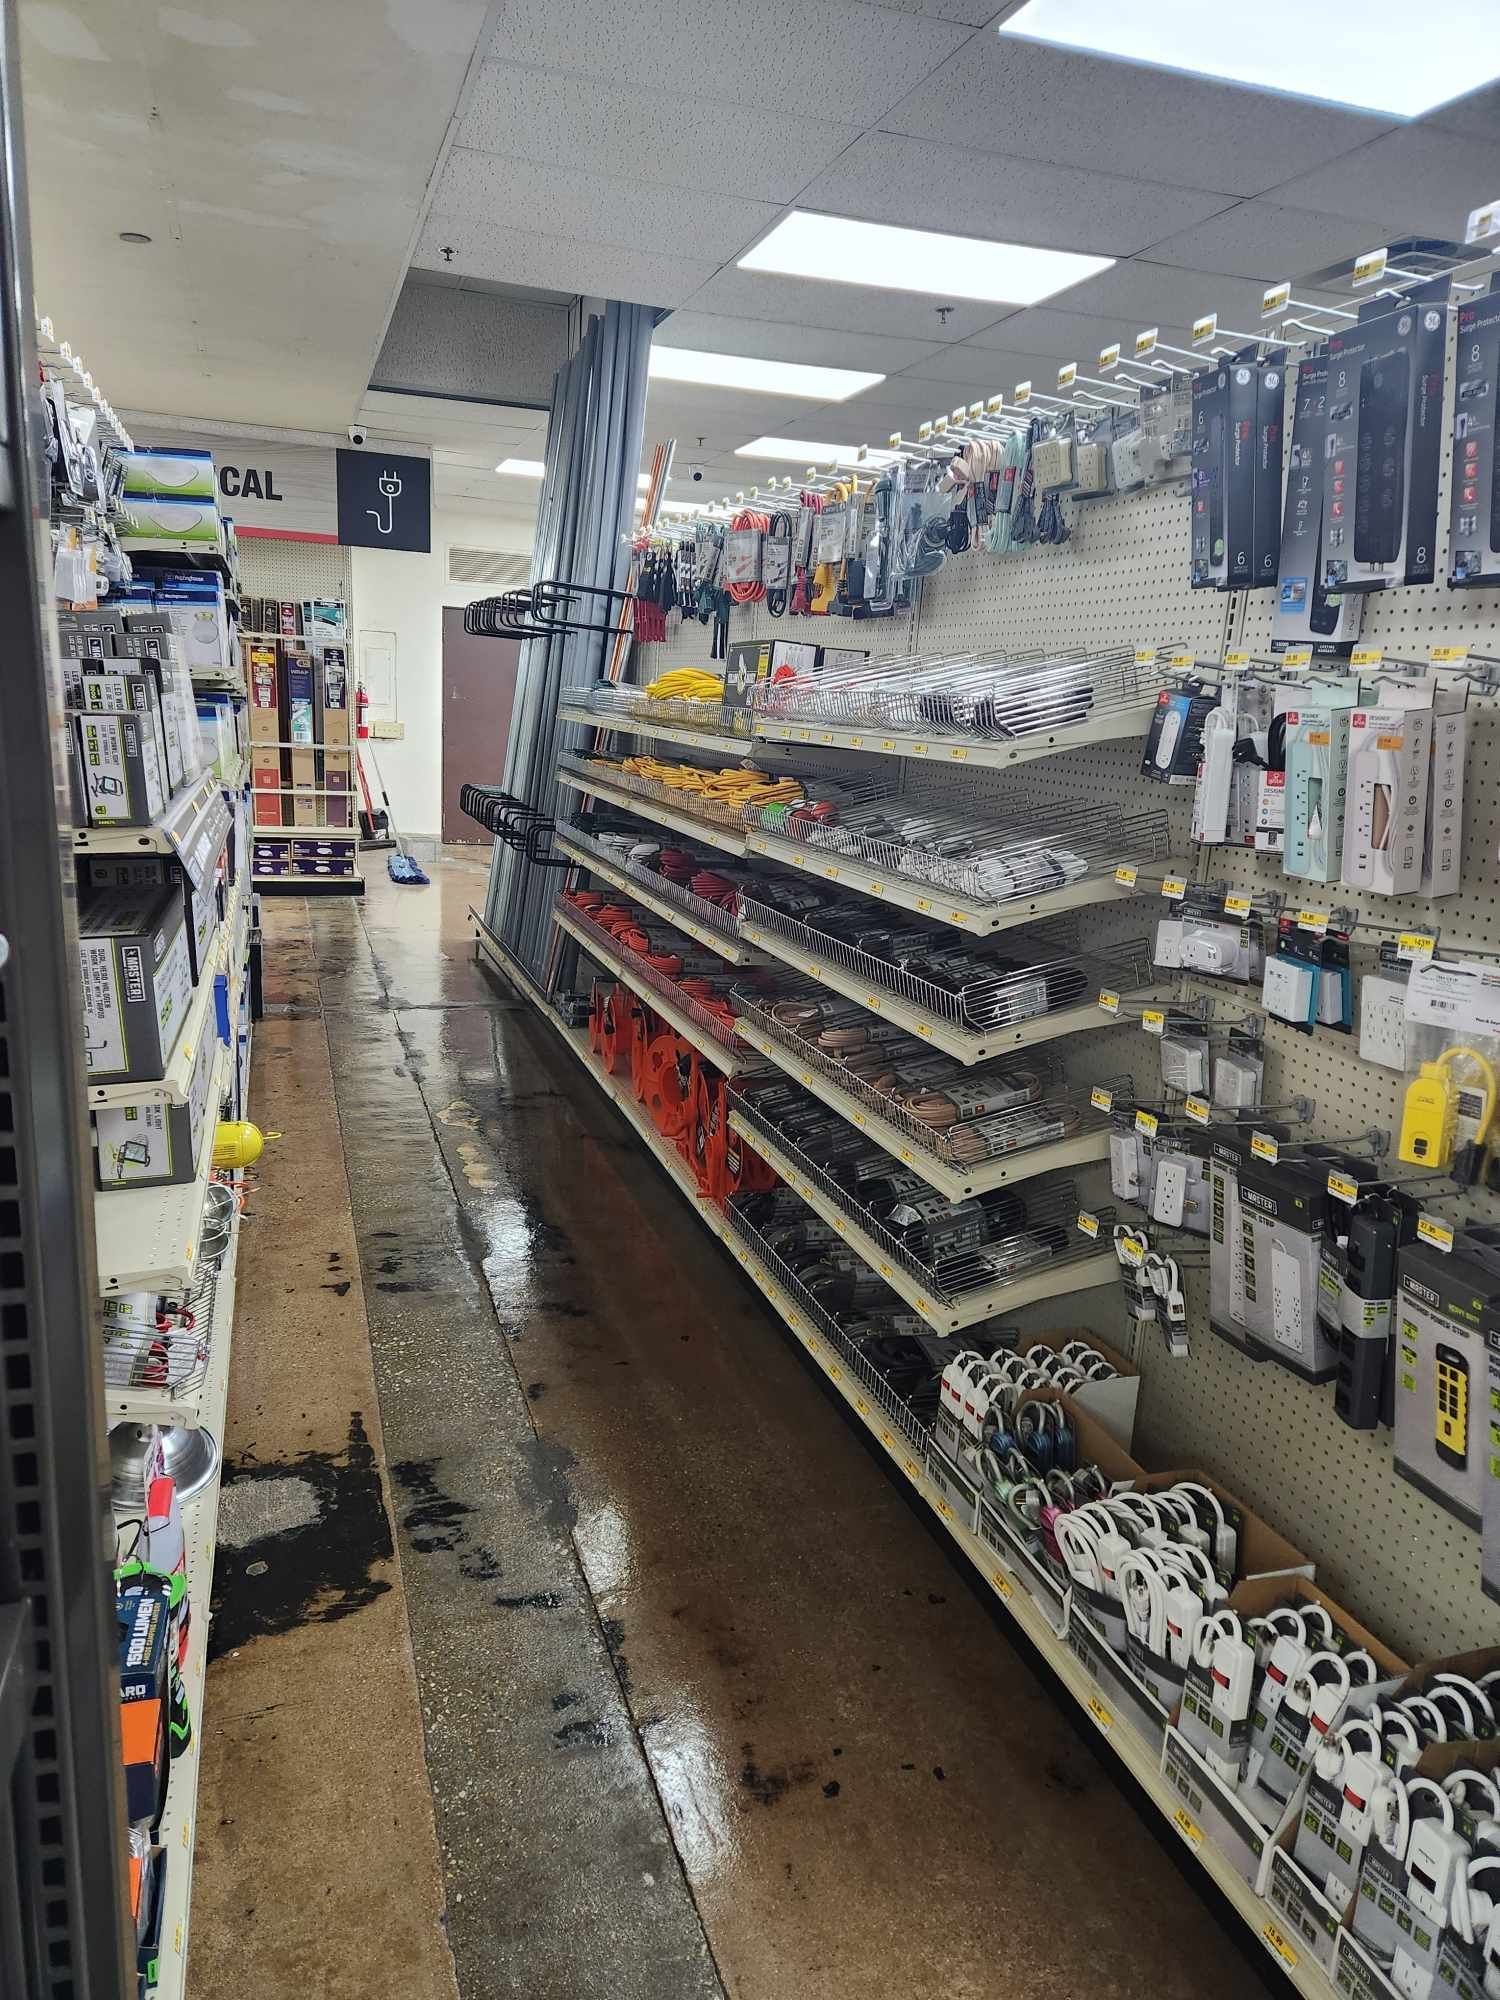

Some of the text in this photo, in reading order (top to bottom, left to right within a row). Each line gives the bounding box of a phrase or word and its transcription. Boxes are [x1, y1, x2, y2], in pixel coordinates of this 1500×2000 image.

[1476, 314, 1500, 330] Protecto
[1471, 344, 1480, 362] 8
[1338, 370, 1346, 388] 8
[1303, 398, 1310, 411] 7
[1318, 396, 1326, 409] 2
[1197, 410, 1205, 425] 6
[1237, 551, 1245, 566] 6
[1264, 554, 1272, 569] 6
[1416, 546, 1426, 565] 8
[1219, 1148, 1239, 1163] MASTER
[1247, 1190, 1273, 1211] MASTER
[1409, 1281, 1435, 1301] MASTER
[126, 1598, 156, 1666] 1500 LUMEN
